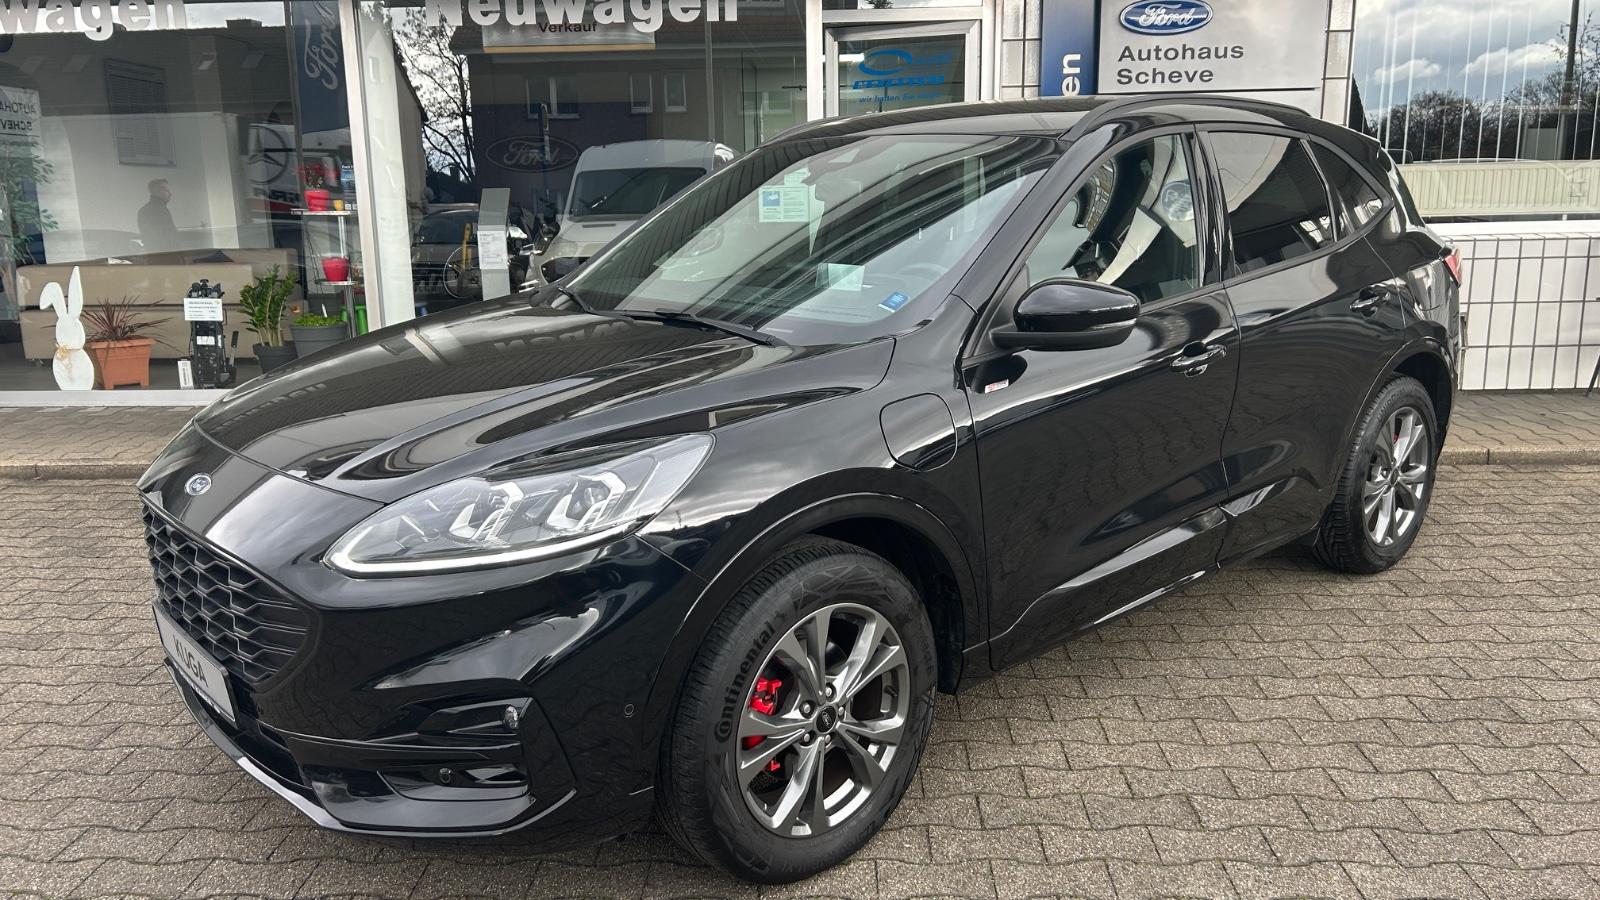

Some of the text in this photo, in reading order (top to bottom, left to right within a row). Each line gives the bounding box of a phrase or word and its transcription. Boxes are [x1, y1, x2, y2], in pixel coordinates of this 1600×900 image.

[425, 0, 737, 32] Neuwagen
[1138, 3, 1197, 26] Ford
[538, 21, 597, 33] Verkauf
[1117, 44, 1244, 62] Autohaus
[1116, 67, 1214, 85] Scheve
[173, 634, 209, 688] KUGA
